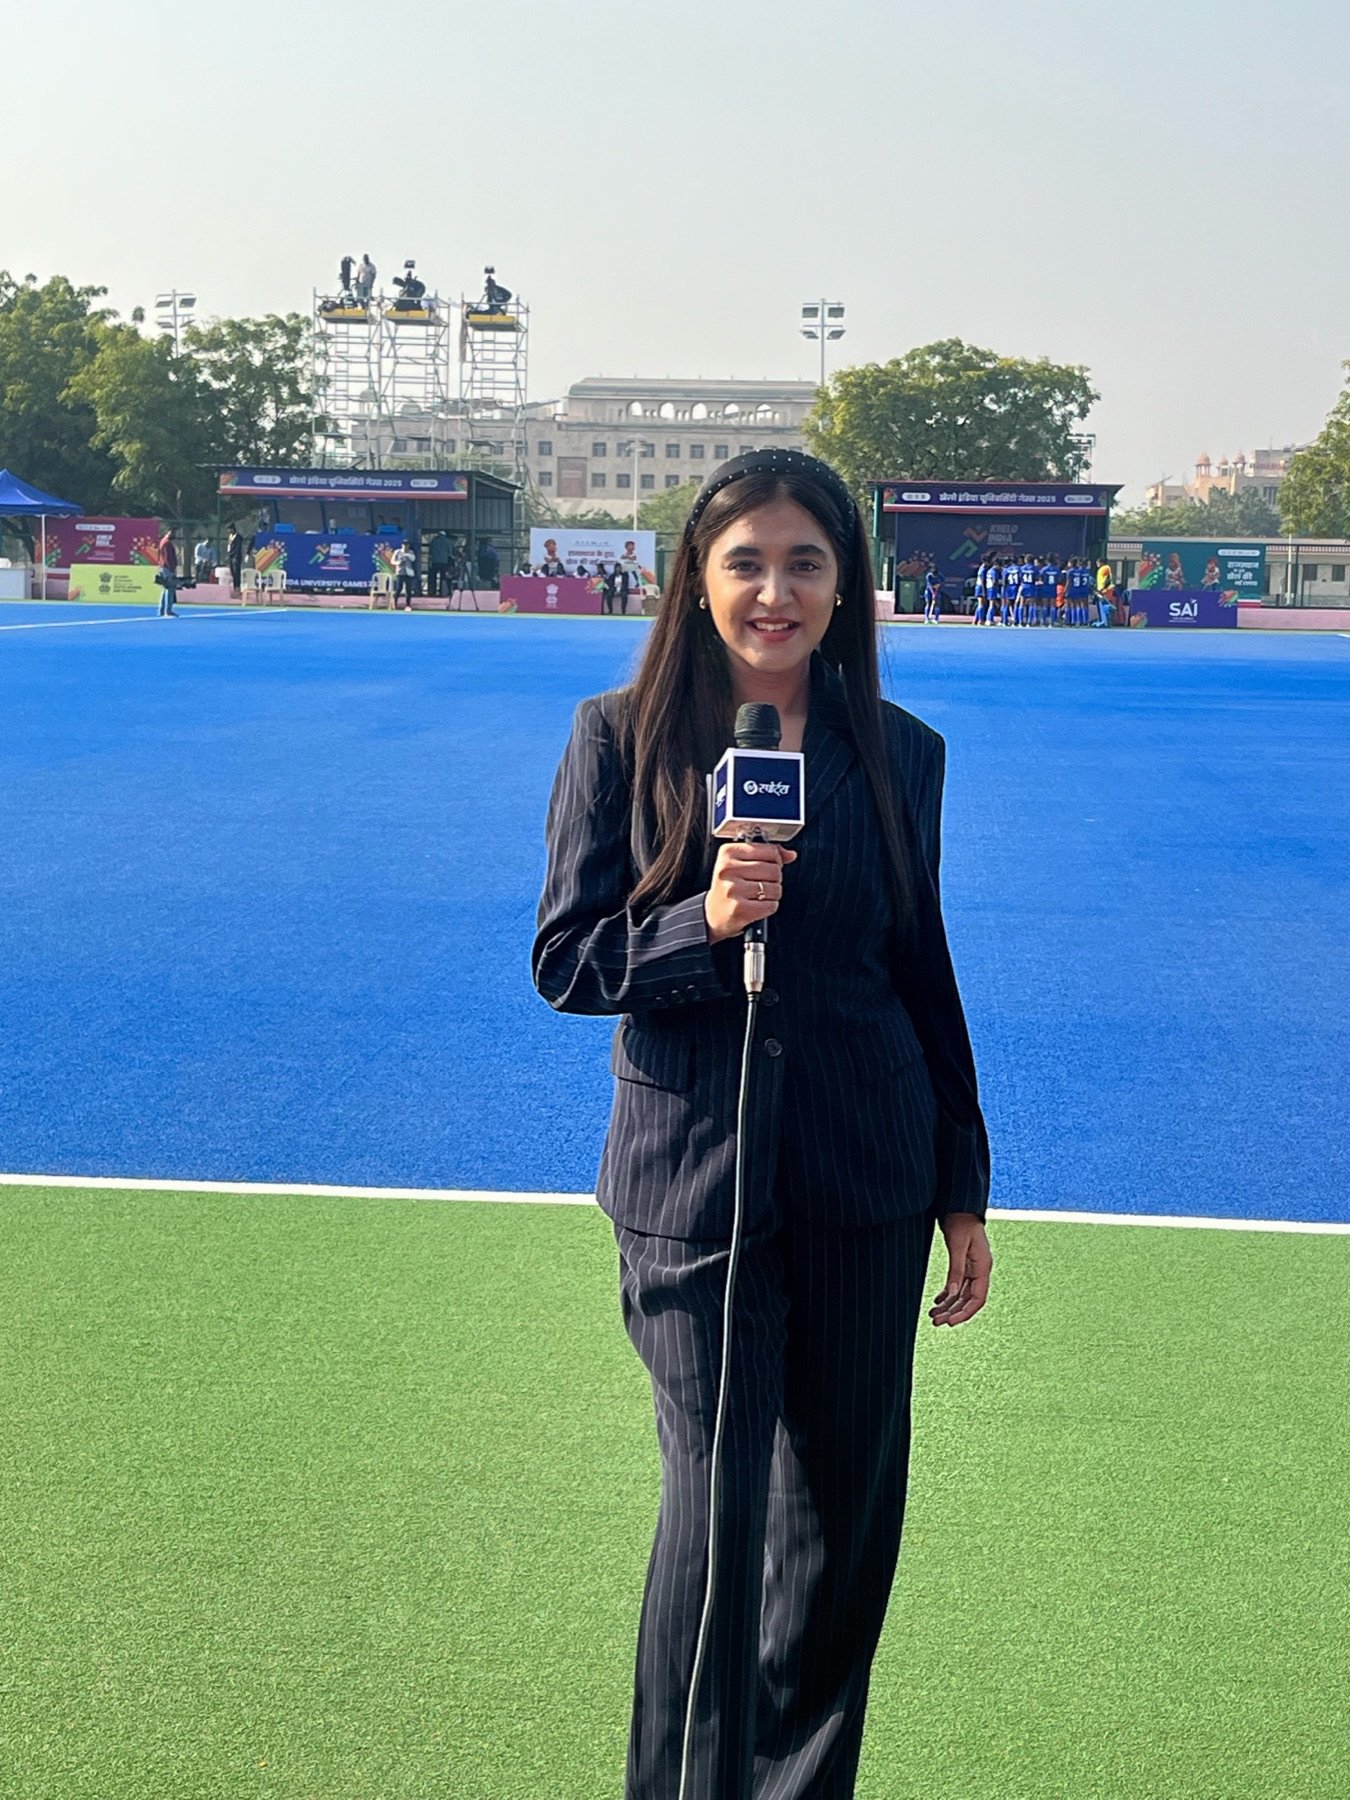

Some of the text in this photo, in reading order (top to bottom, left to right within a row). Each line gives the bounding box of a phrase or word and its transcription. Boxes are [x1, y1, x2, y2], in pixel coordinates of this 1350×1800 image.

[939, 492, 957, 501] खेलो
[1036, 495, 1056, 503] 2025
[989, 524, 1018, 534] KHELO
[988, 533, 1013, 543] INDIA
[300, 579, 341, 587] UNIVERSITY
[342, 580, 368, 588] GAMES
[1168, 599, 1198, 617] SAI
[758, 781, 791, 797] स्पोर्ट्स
